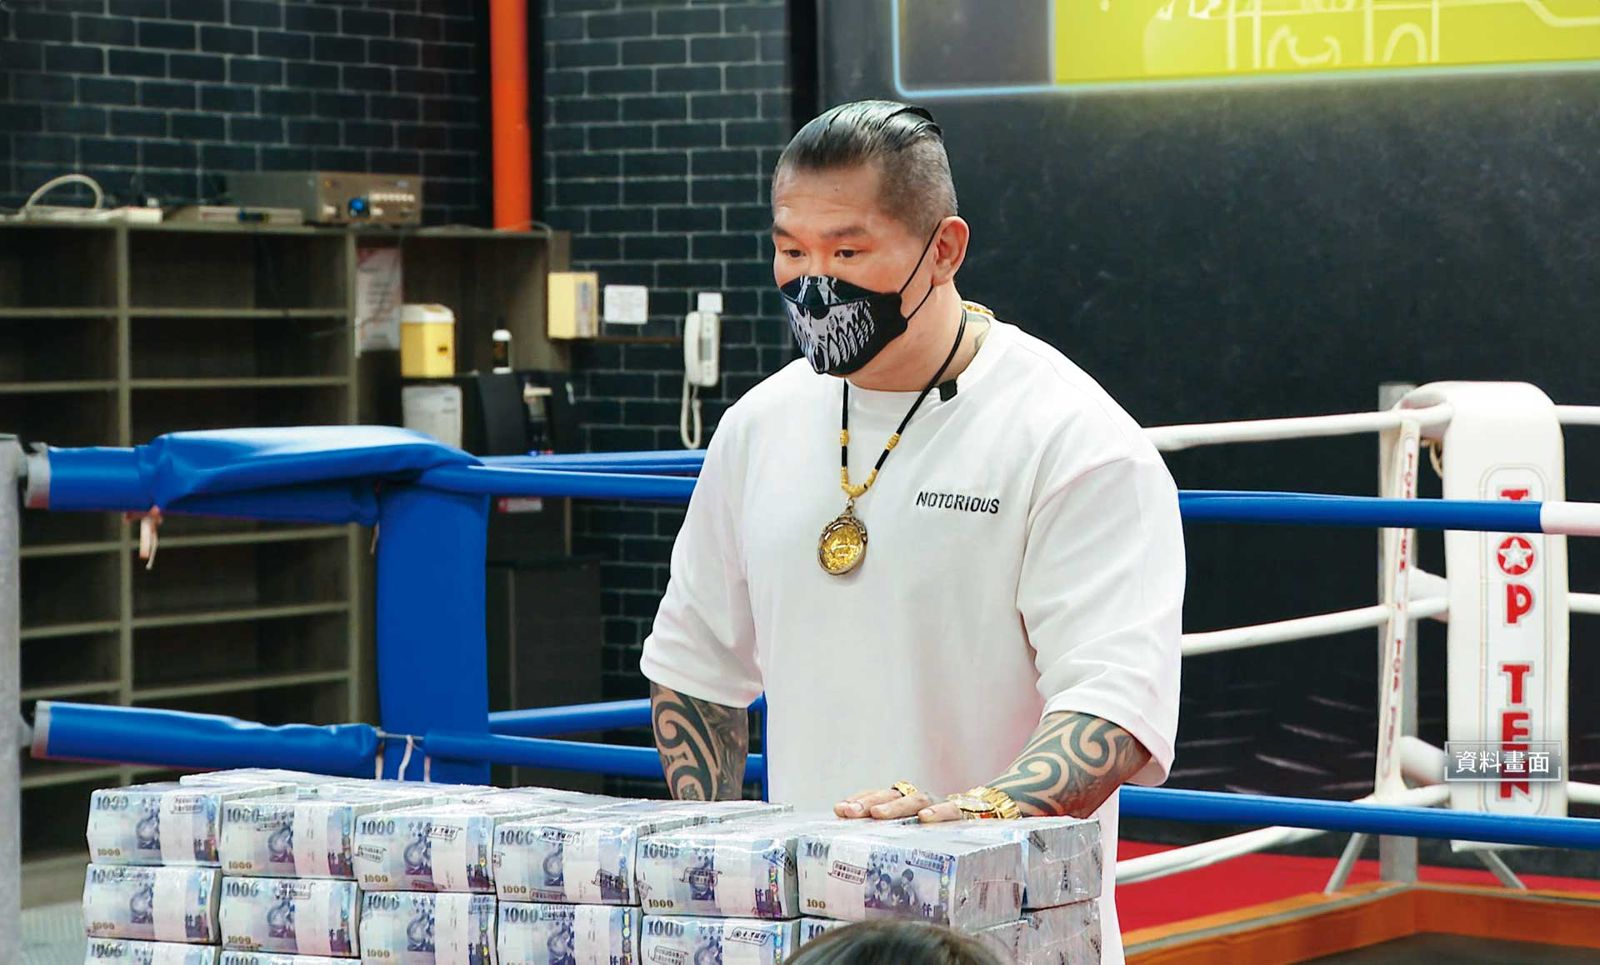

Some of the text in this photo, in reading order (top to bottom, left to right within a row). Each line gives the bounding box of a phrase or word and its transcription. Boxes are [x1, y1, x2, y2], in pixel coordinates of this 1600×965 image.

[915, 491, 1000, 515] NOTORIOUS
[361, 820, 395, 835] 1000
[499, 830, 533, 845] 1000
[643, 843, 679, 859] 1000
[229, 861, 252, 869] 1000
[364, 874, 388, 882] 1000
[226, 882, 259, 897] 1000
[503, 885, 526, 893] 1000
[649, 900, 673, 908] 1000
[504, 907, 537, 923] 1000
[648, 920, 684, 936] 1000
[367, 949, 390, 958] 1000
